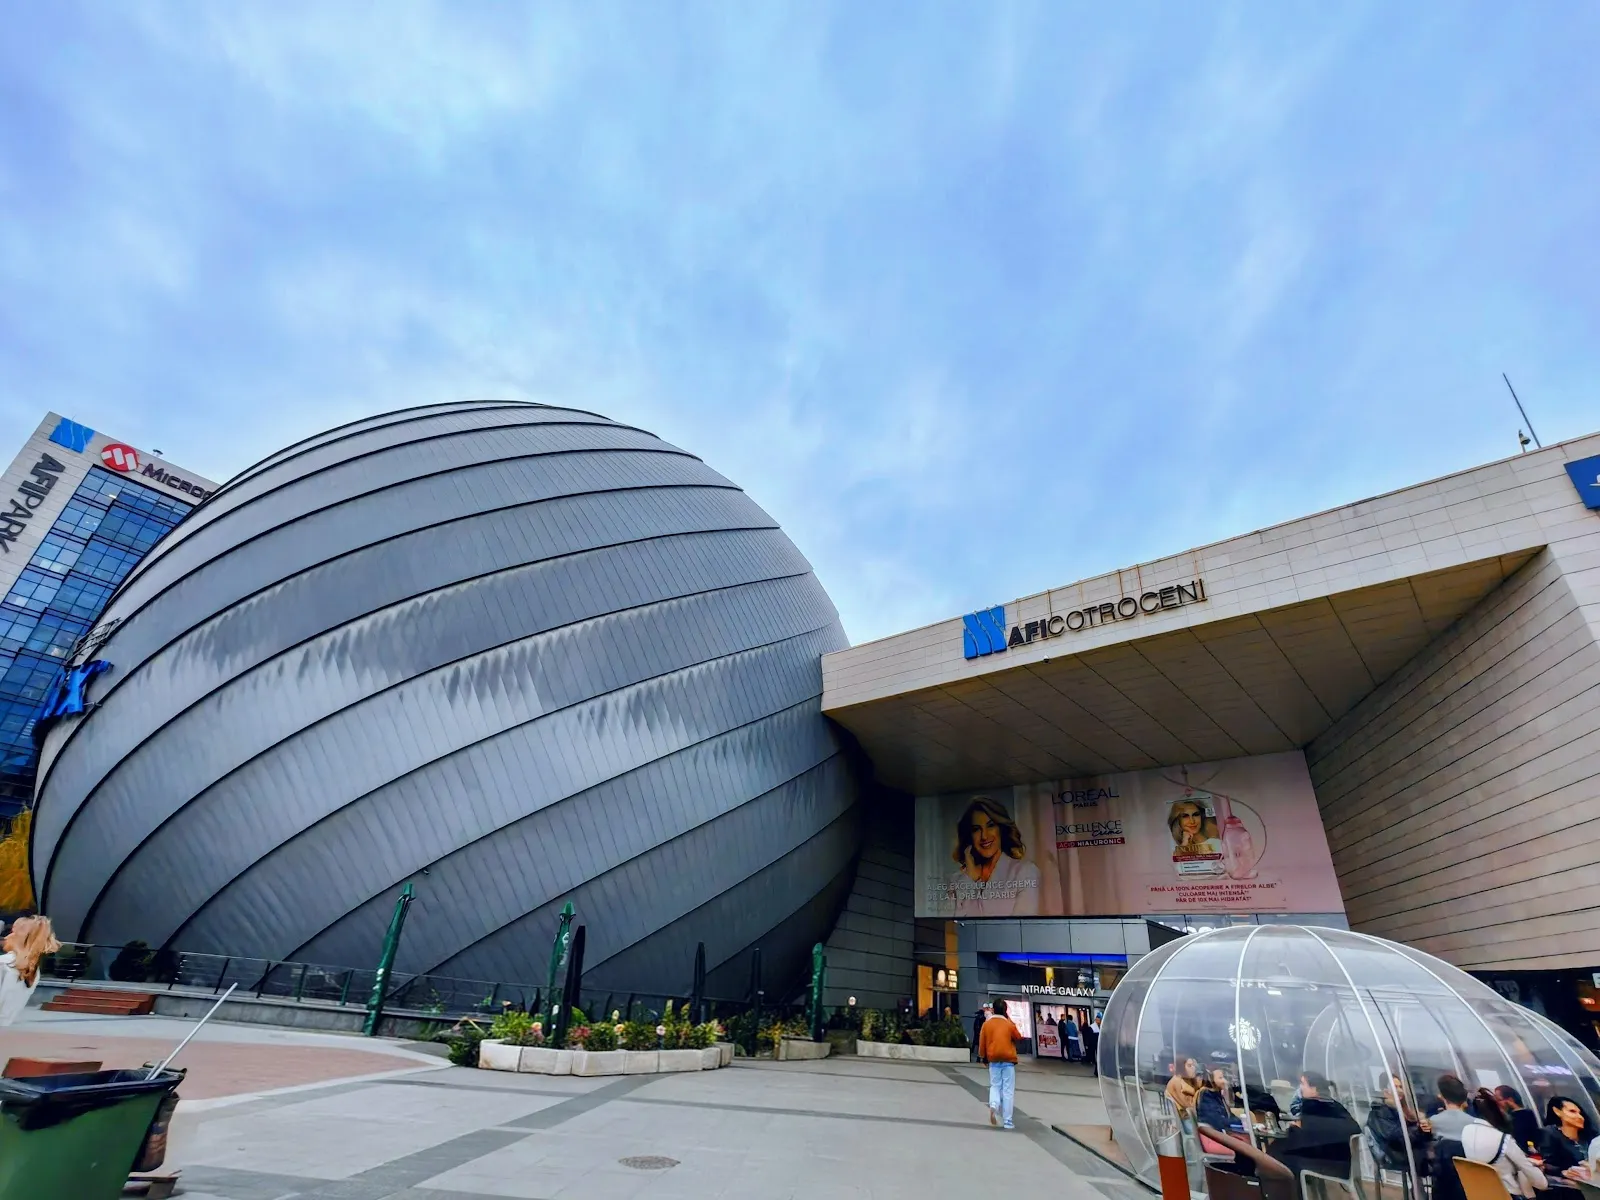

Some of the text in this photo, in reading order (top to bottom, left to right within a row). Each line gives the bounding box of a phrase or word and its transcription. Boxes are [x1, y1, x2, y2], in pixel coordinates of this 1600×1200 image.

[1056, 819, 1121, 835] EXCELLENCE
[1077, 838, 1122, 847] HIALURONIC
[990, 890, 1016, 899] PARIS
[1021, 984, 1096, 997] INTRARE GALAXY
